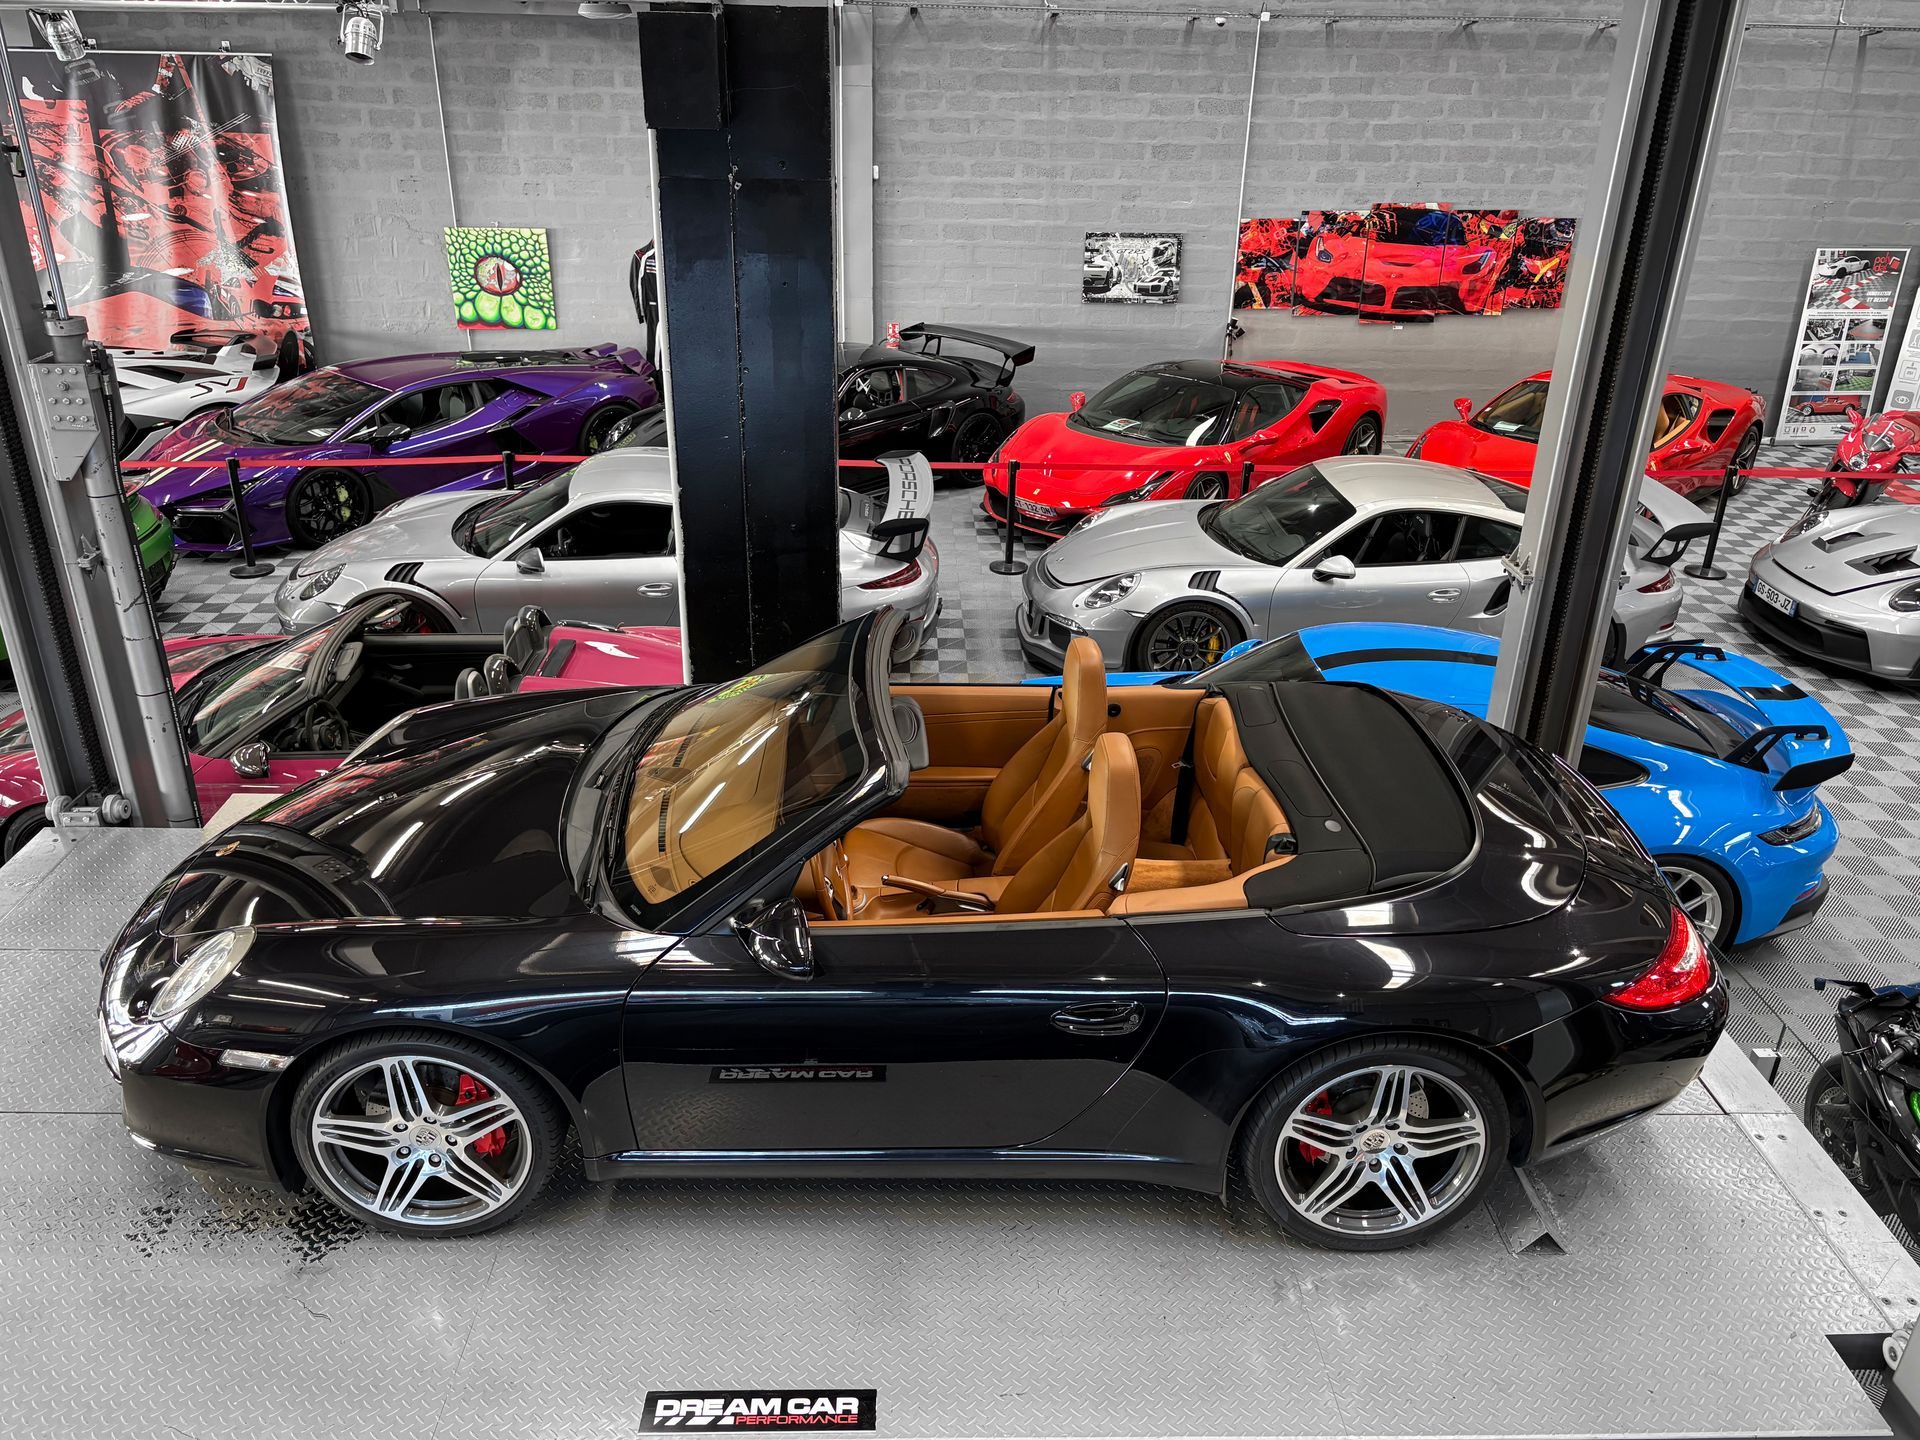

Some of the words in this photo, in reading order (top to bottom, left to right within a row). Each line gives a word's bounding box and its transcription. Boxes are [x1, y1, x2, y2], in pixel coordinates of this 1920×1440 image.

[897, 458, 918, 519] PORSCHE
[655, 1398, 782, 1416] DREAM
[787, 1397, 859, 1415] CAR
[735, 1414, 858, 1425] PERFORMANCE
